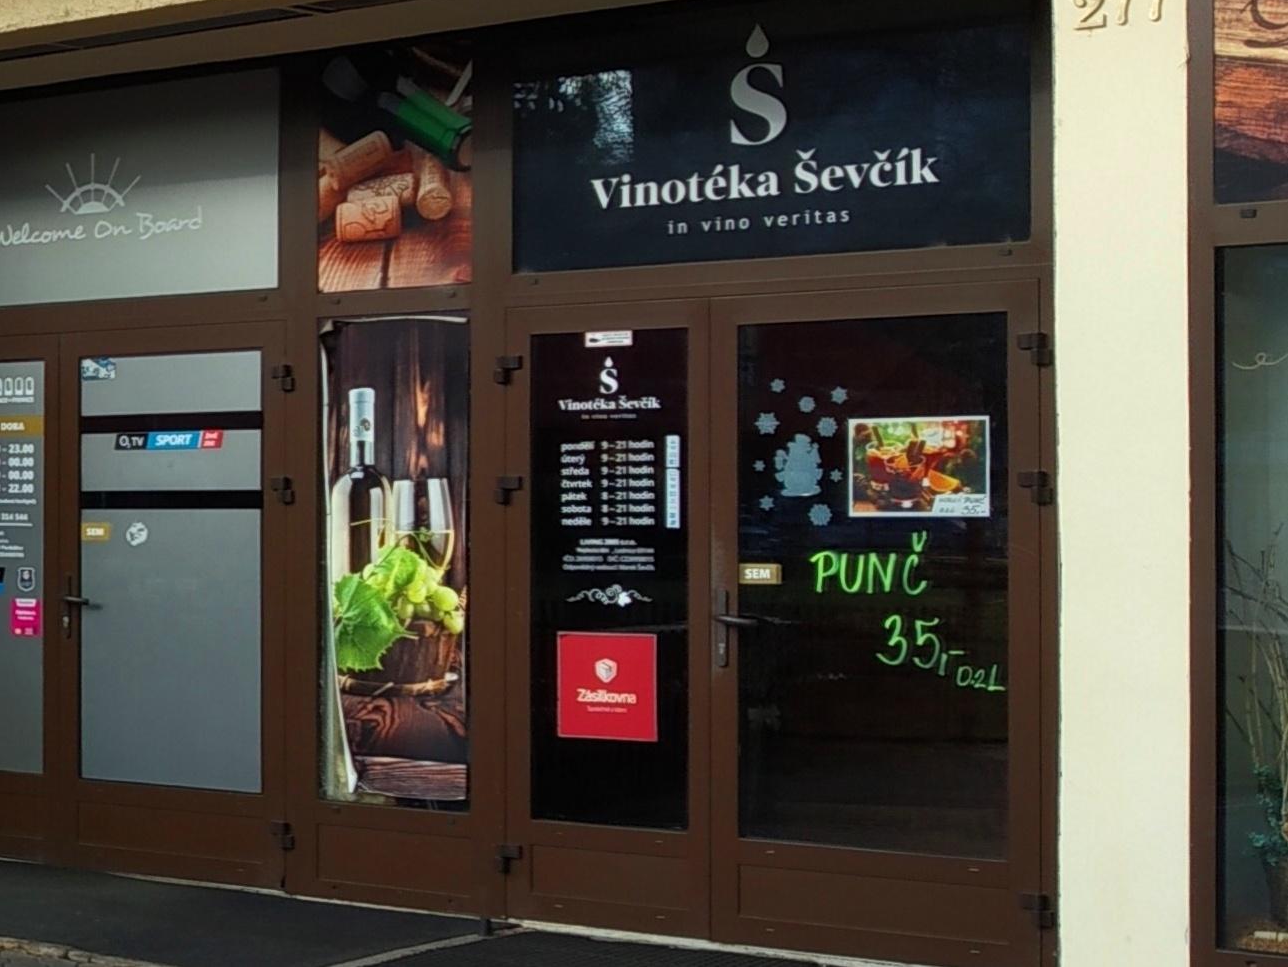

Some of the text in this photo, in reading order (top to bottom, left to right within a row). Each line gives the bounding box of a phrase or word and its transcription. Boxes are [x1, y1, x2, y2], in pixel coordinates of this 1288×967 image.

[591, 147, 941, 211] Vinotéka Ševčík
[94, 220, 132, 239] On
[136, 205, 203, 241] Board
[667, 209, 851, 236] in vino veritas
[558, 395, 662, 411] Vinotéka Ševčík
[0, 423, 25, 431] DOBA
[155, 434, 192, 446] SPORT
[628, 440, 655, 450] hodin
[560, 454, 586, 465] úterý
[628, 452, 655, 462] hodin
[560, 467, 590, 476] středa
[628, 465, 655, 475] hodin
[560, 479, 593, 488] čtvrtek
[628, 478, 655, 488] hodin
[561, 492, 588, 503] pátek
[628, 491, 655, 500] hodin
[561, 504, 592, 513] sobota
[628, 503, 655, 513] hodin
[561, 516, 592, 526] neděle
[628, 516, 655, 526] hodin
[809, 531, 928, 596] PUNČ
[744, 568, 771, 579] SEM
[576, 688, 637, 704] Zásilkovna
